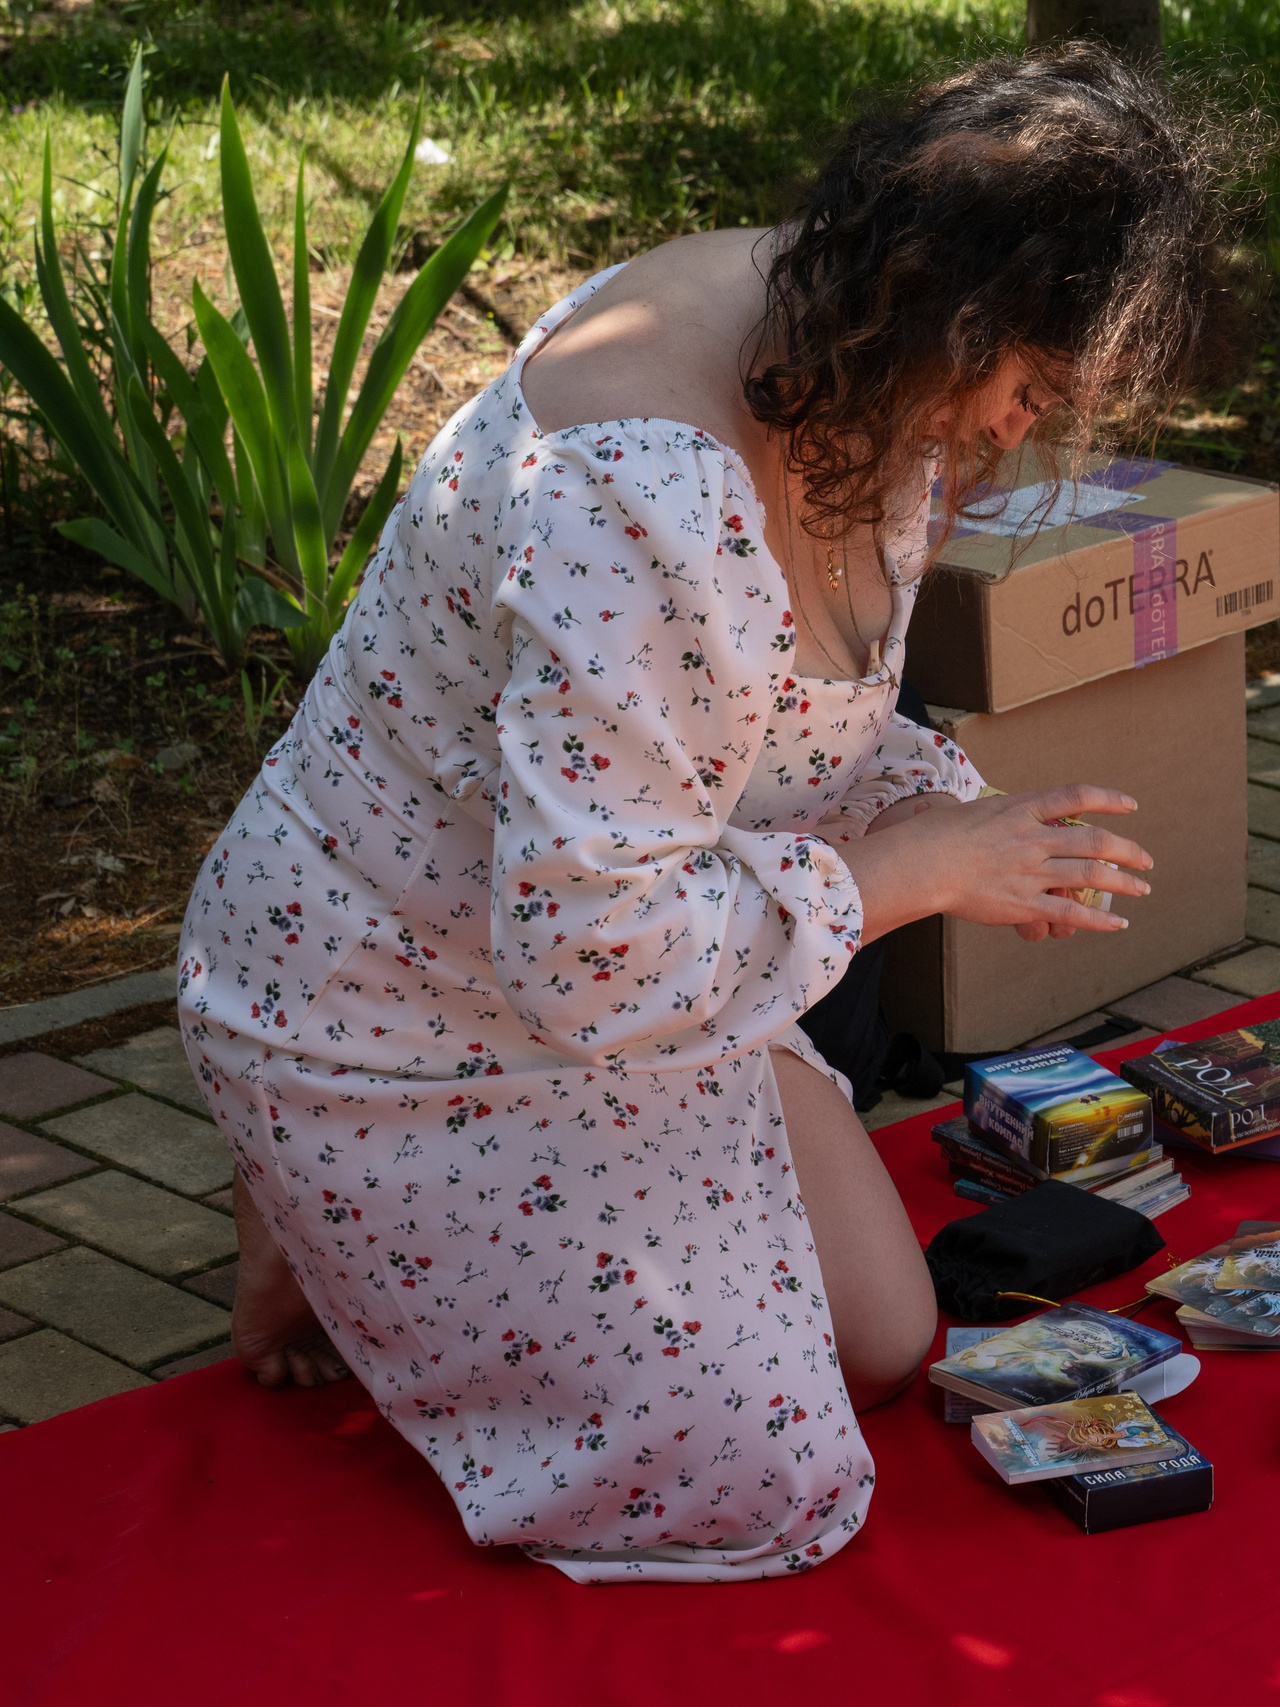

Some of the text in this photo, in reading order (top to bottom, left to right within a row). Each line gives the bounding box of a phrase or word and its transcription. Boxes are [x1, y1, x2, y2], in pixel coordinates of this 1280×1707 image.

[984, 1048, 1075, 1073] ВНУТРЕННИЙ
[1011, 1057, 1068, 1074] КОМПАС
[1173, 1058, 1254, 1097] РОД
[979, 1093, 1034, 1141] ВНУТРЕННИЙ
[988, 1117, 1025, 1149] КОМПАС
[1084, 1455, 1202, 1485] СИЛА РОДА
